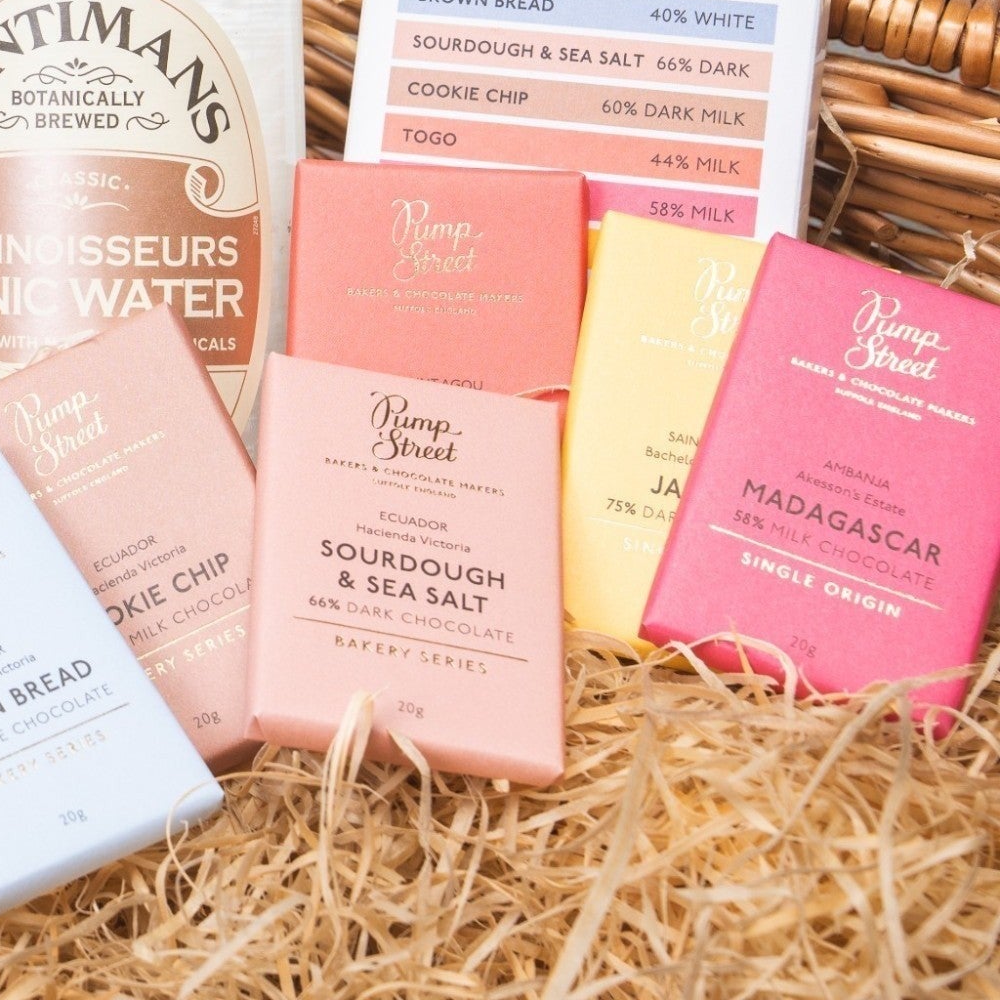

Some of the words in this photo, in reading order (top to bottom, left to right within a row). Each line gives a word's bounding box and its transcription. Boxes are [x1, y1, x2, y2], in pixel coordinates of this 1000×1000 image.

[650, 7, 688, 24] 40%
[694, 11, 755, 30] WHITE
[413, 34, 534, 59] SOURDOUGH
[540, 45, 552, 60] &
[559, 48, 591, 64] SEA
[599, 50, 644, 68] SALT
[657, 56, 693, 73] 66%
[699, 60, 750, 79] DARK
[11, 90, 145, 107] BOTANICALLY
[407, 81, 480, 102] COOKIE
[486, 88, 529, 106] CHIP
[35, 113, 119, 129] BREWED
[602, 99, 637, 116] 60%
[644, 103, 694, 122] DARK
[701, 108, 745, 127] MILK
[402, 128, 457, 147] TOGO
[650, 152, 689, 171] 44%
[696, 156, 740, 176] MILK
[392, 199, 484, 250] Pump
[649, 201, 685, 219] 58%
[692, 204, 735, 224] MILK
[392, 240, 478, 282] Street
[68, 277, 245, 319] WATER
[852, 289, 950, 355] Pump
[844, 334, 938, 381] Street
[4, 390, 99, 445] Pump
[370, 391, 463, 442] Pump
[850, 377, 925, 407] CHOCOLATE
[927, 403, 976, 425] MAKERS
[34, 411, 109, 477] Street
[372, 430, 458, 463] Street
[56, 451, 120, 488] CHOCOLATE
[325, 457, 367, 471] BAKERS
[384, 468, 454, 487] CHOCOLATE
[459, 482, 505, 497] MAKERS
[823, 459, 890, 490] AMBANJA
[379, 511, 449, 533] ECUADOR
[607, 498, 636, 515] 75%
[741, 478, 943, 566] MADAGASCAR
[863, 493, 906, 517] Estate
[93, 535, 158, 573] ECUADOR
[356, 523, 417, 544] Hacienda
[420, 533, 471, 554] Victoria
[733, 509, 764, 531] 58%
[770, 521, 814, 546] MILK
[818, 540, 937, 591] CHOCOLATE
[139, 544, 187, 572] Victoria
[172, 552, 230, 594] CHIP
[320, 539, 505, 590] SOURDOUGH
[338, 570, 355, 589] &
[367, 576, 417, 602] SEA
[426, 586, 488, 613] SALT
[740, 552, 814, 588] SINGLE
[824, 580, 902, 618] ORIGIN
[129, 619, 168, 646] MILK
[308, 594, 340, 611] 66%
[346, 601, 394, 621] DARK
[400, 611, 515, 645] CHOCOLATE
[183, 625, 246, 662] SERIES
[335, 635, 412, 660] BAKERY
[420, 650, 488, 675] SERIES
[789, 635, 817, 660] 20g
[9, 658, 93, 708] BREAD
[11, 682, 114, 736] CHOCOLATE
[193, 710, 221, 729] 20g
[398, 699, 425, 719] 20g
[45, 729, 108, 765] SERIES
[58, 808, 88, 827] 20g
